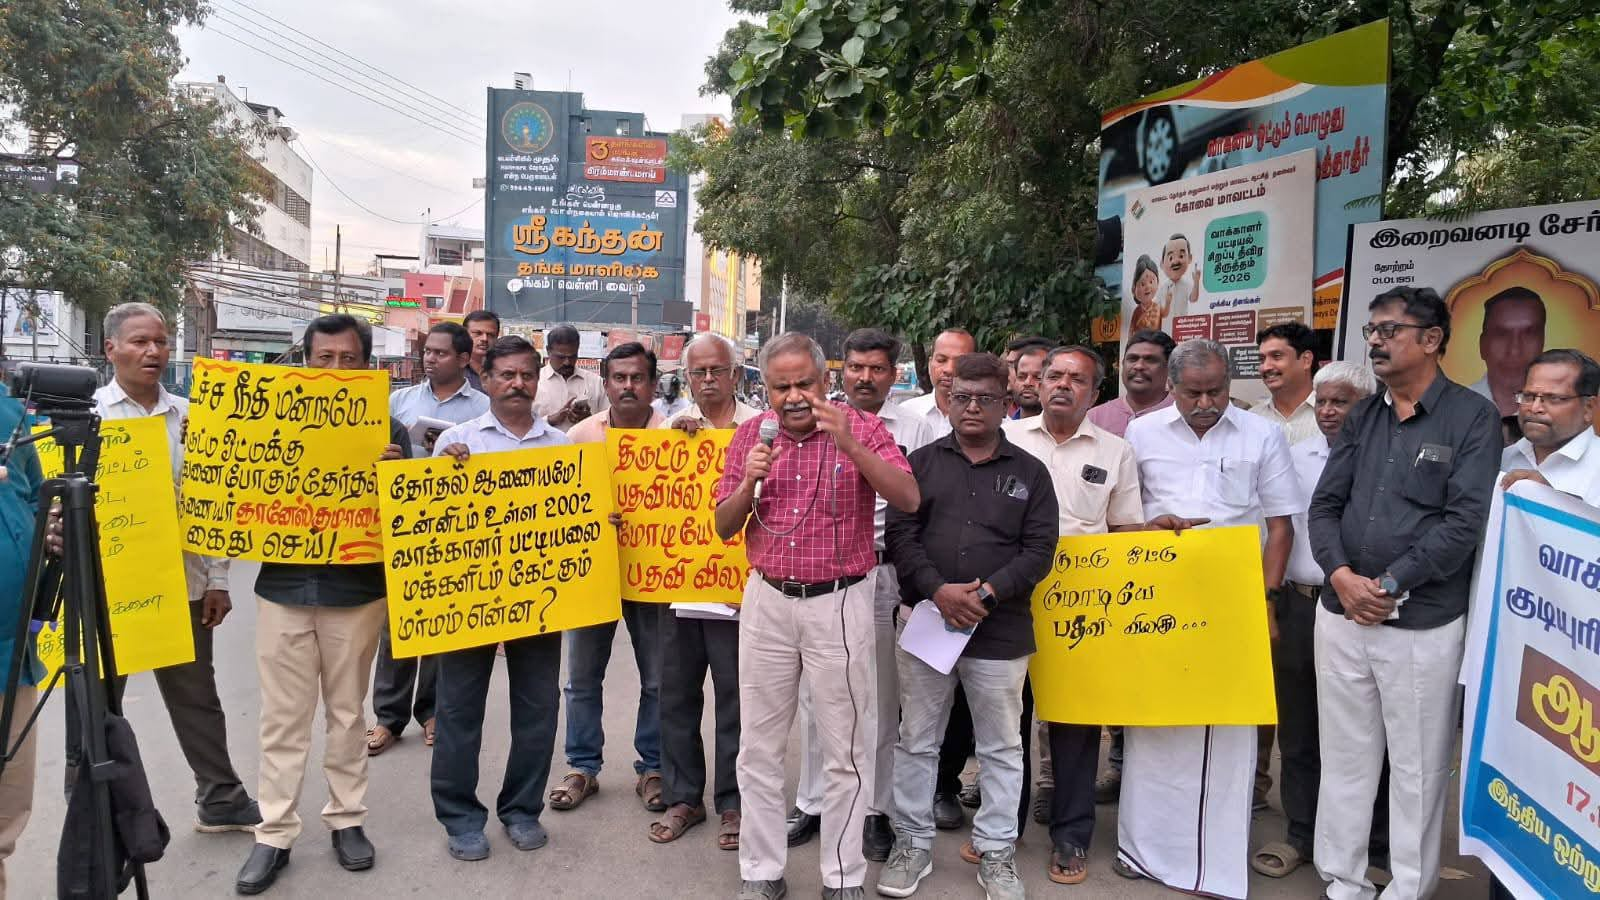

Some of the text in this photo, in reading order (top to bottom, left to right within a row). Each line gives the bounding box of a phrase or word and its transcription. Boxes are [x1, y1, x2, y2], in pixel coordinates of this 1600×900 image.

[1294, 106, 1344, 140] பொழுது
[1316, 136, 1370, 181] த்தாதீர்
[1174, 183, 1266, 214] கோவை மாவட்டம்
[1210, 221, 1262, 239] வாக்காளர்
[1217, 234, 1253, 249] பட்டியல்
[1369, 221, 1530, 250] இறைவனடி
[517, 259, 660, 279] தங்க மாளிகை
[1207, 245, 1264, 262] சிறப்பு தீவிர
[1214, 257, 1256, 274] திருத்தம்
[1374, 259, 1415, 274] தோற்றம்
[522, 277, 551, 289] ங்கம்
[558, 278, 599, 291] வெள்ளி
[226, 370, 275, 421] நீதி
[614, 434, 690, 474] திருட்டு
[390, 449, 583, 504] தேர்தல் ஆணையமே!
[617, 473, 702, 512] பதவியில்
[391, 493, 593, 537] உன்னிடம் உள்ள 2002
[187, 525, 253, 557] கைது
[391, 520, 601, 570] வாக்காளர் பட்டியலை
[618, 516, 714, 558] மோடியே
[403, 549, 593, 601] மக்களிடம் கேட்கும்
[627, 554, 748, 592] பதவி வில
[1054, 547, 1110, 573] ருட்டு
[397, 603, 463, 641] மர்மம்
[1054, 615, 1113, 650] பதவி
[1488, 778, 1550, 845] இந்திய
